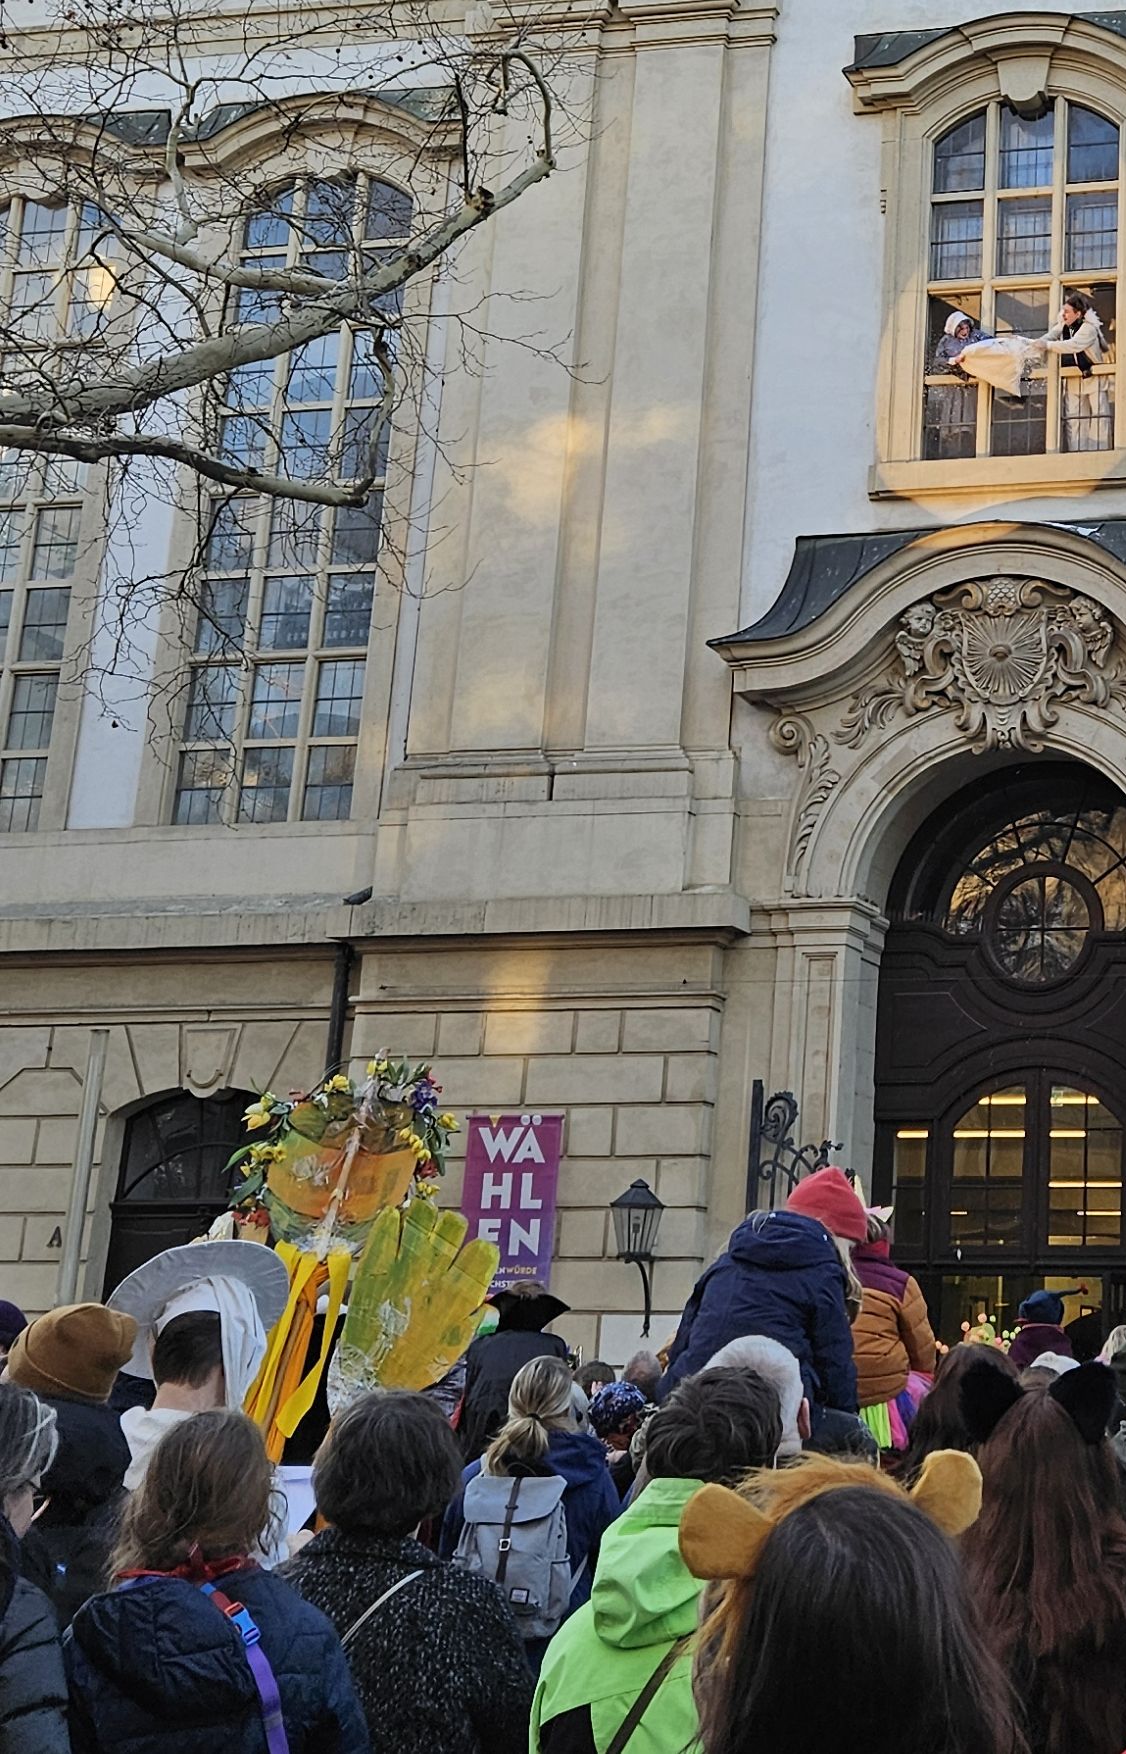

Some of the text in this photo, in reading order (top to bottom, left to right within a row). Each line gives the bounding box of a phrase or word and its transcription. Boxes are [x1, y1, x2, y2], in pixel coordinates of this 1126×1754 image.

[478, 1115, 545, 1163] WÄ
[480, 1173, 543, 1209] HL
[46, 1225, 62, 1248] A
[477, 1218, 541, 1256] EN
